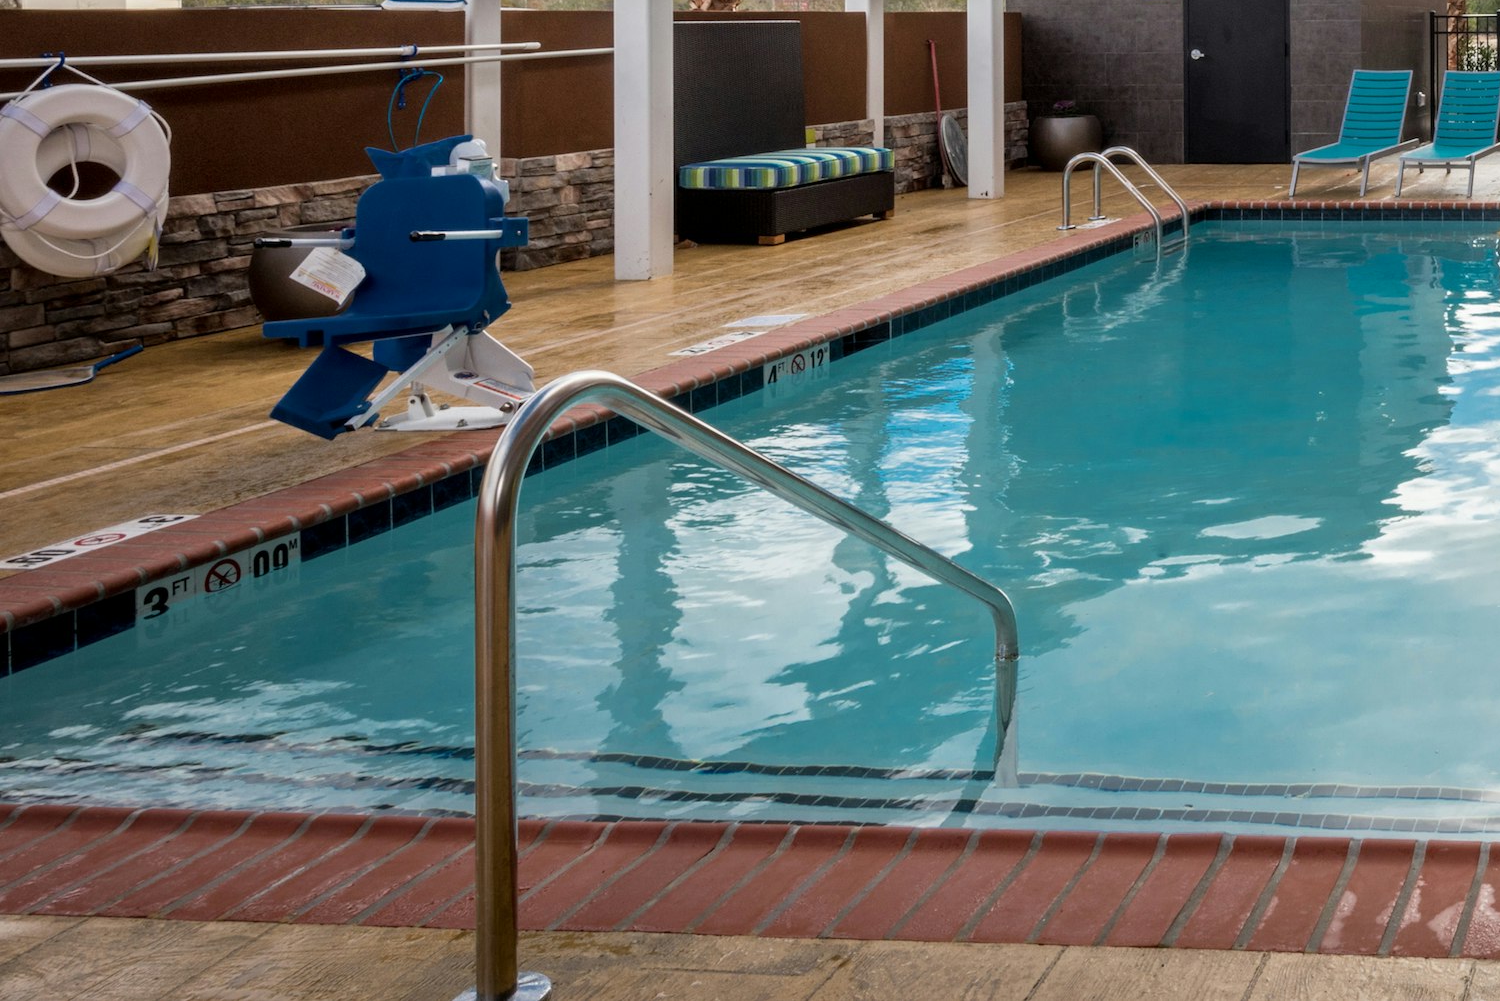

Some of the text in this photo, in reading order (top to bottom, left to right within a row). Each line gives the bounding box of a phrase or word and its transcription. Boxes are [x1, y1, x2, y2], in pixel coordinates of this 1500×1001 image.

[144, 587, 169, 619] 3
[172, 576, 190, 596] FT
[288, 538, 298, 550] M
